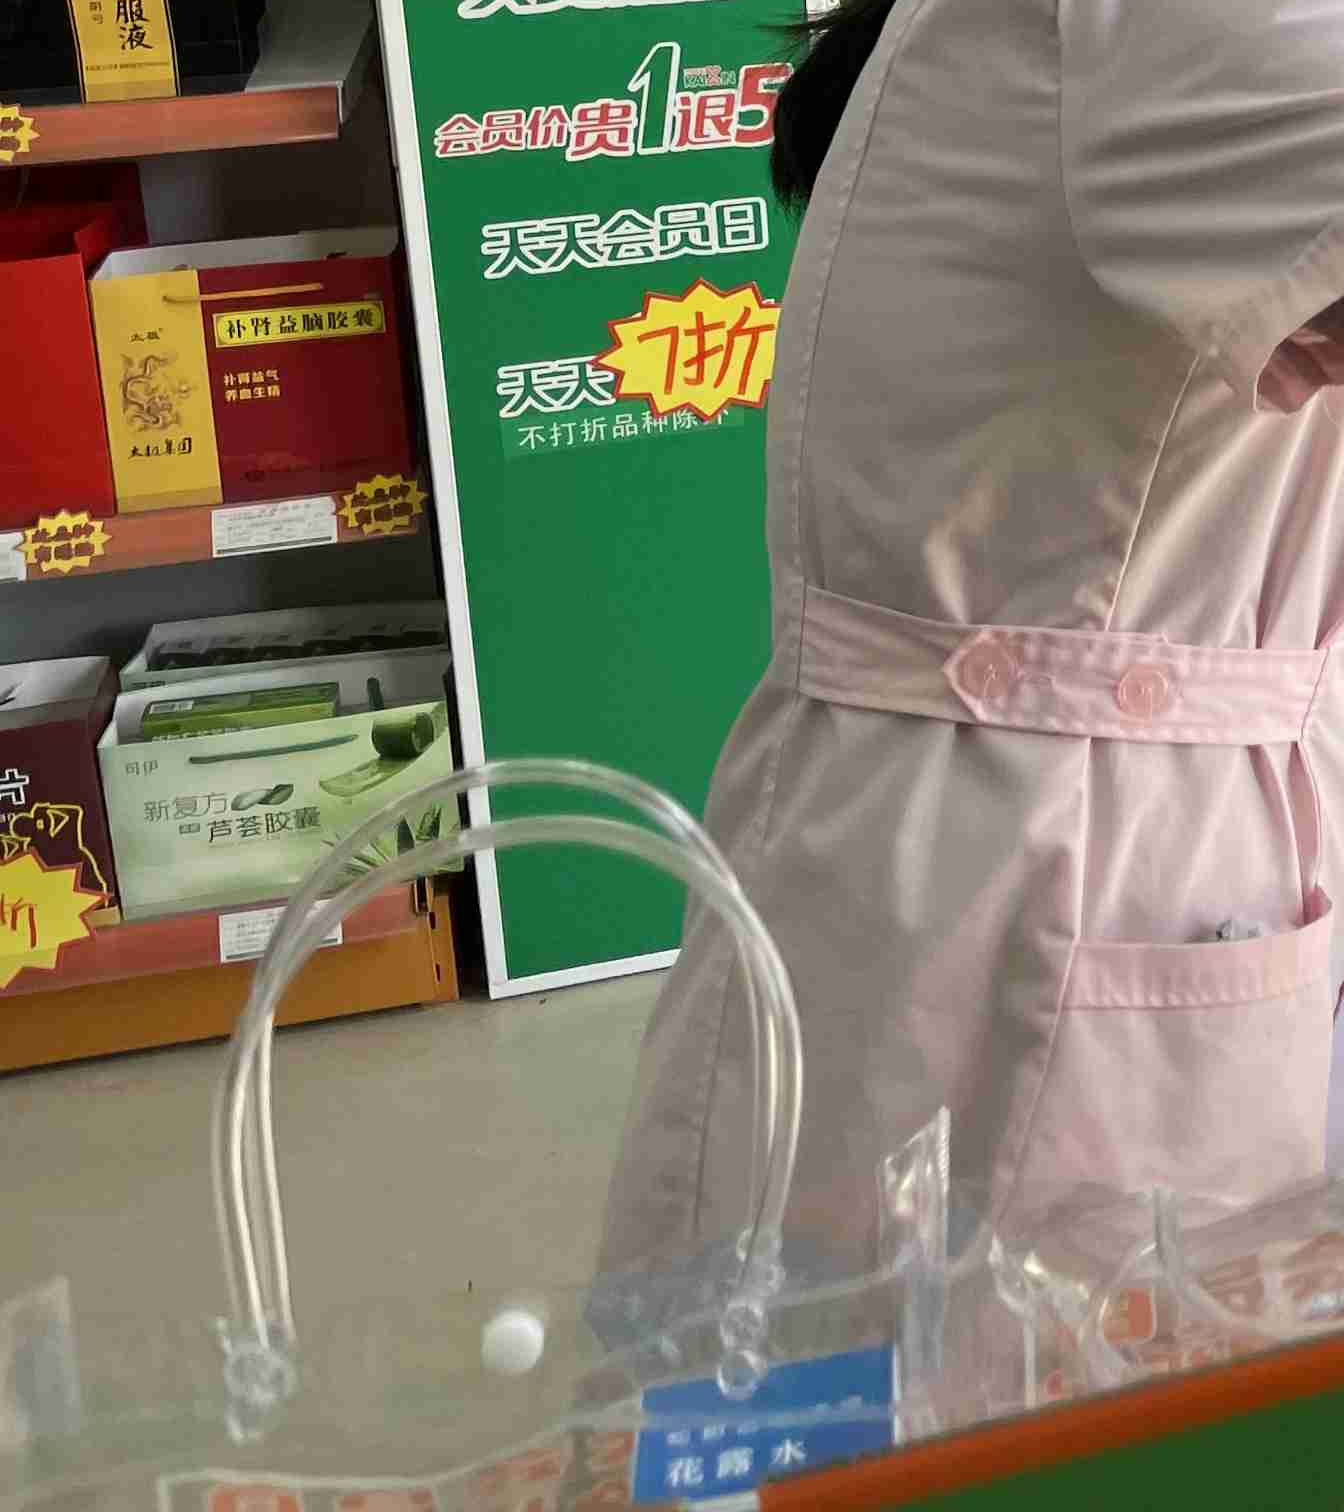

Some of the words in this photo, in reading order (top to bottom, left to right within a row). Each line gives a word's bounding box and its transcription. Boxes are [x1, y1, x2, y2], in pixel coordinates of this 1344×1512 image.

[481, 197, 769, 279] 天天会员日
[224, 309, 376, 339] 补肾益脑胶囊
[143, 793, 228, 823] 新复方
[207, 805, 321, 844] 芦荟胶囊
